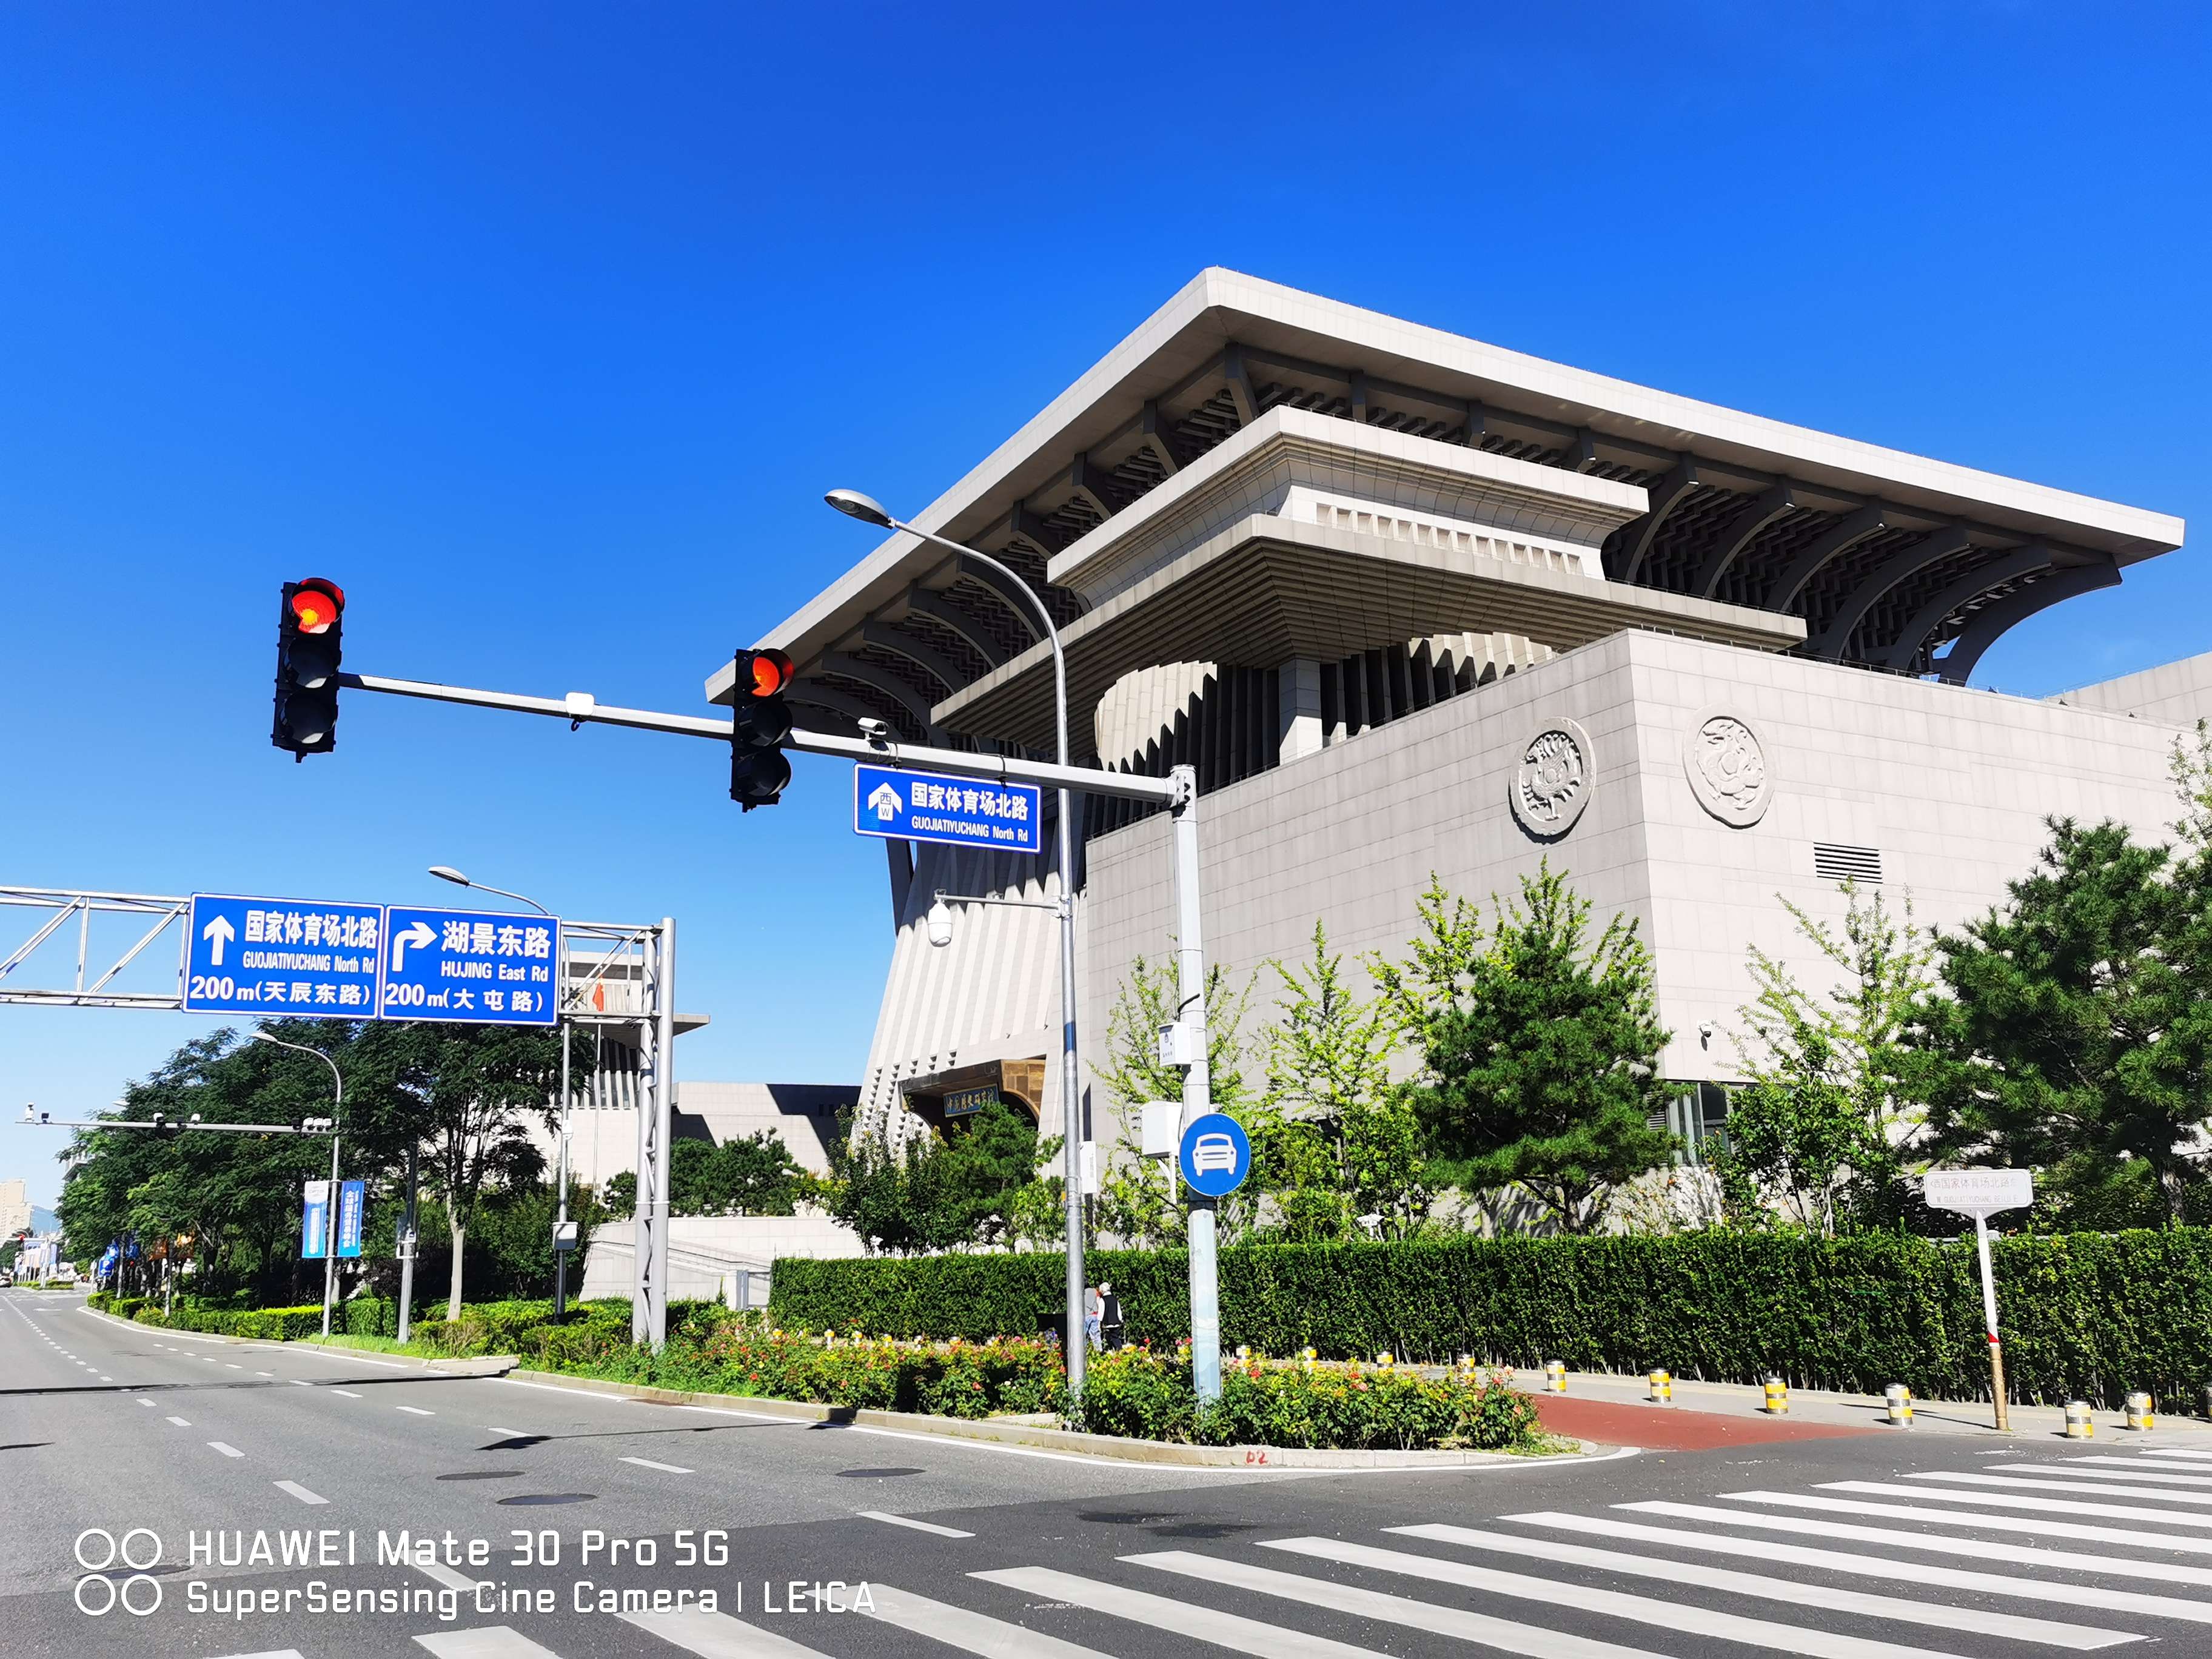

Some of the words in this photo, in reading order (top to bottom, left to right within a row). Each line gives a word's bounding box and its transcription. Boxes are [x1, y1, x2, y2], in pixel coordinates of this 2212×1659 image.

[879, 792, 891, 805] 西
[911, 782, 1028, 820] 国家体育场北路
[881, 808, 890, 817] W
[911, 816, 989, 838] GUOJIATIYUCHANG
[993, 827, 1014, 840] North
[1018, 829, 1028, 842] Rd
[245, 910, 378, 949] 国家体育场北路
[441, 920, 551, 959] 湖景东路
[243, 951, 330, 971] GUOJIATIYUCHANG
[334, 955, 358, 973] North
[363, 957, 375, 974] Rd
[441, 960, 492, 979] HUJING
[498, 964, 526, 981] East
[531, 965, 548, 982] Rd
